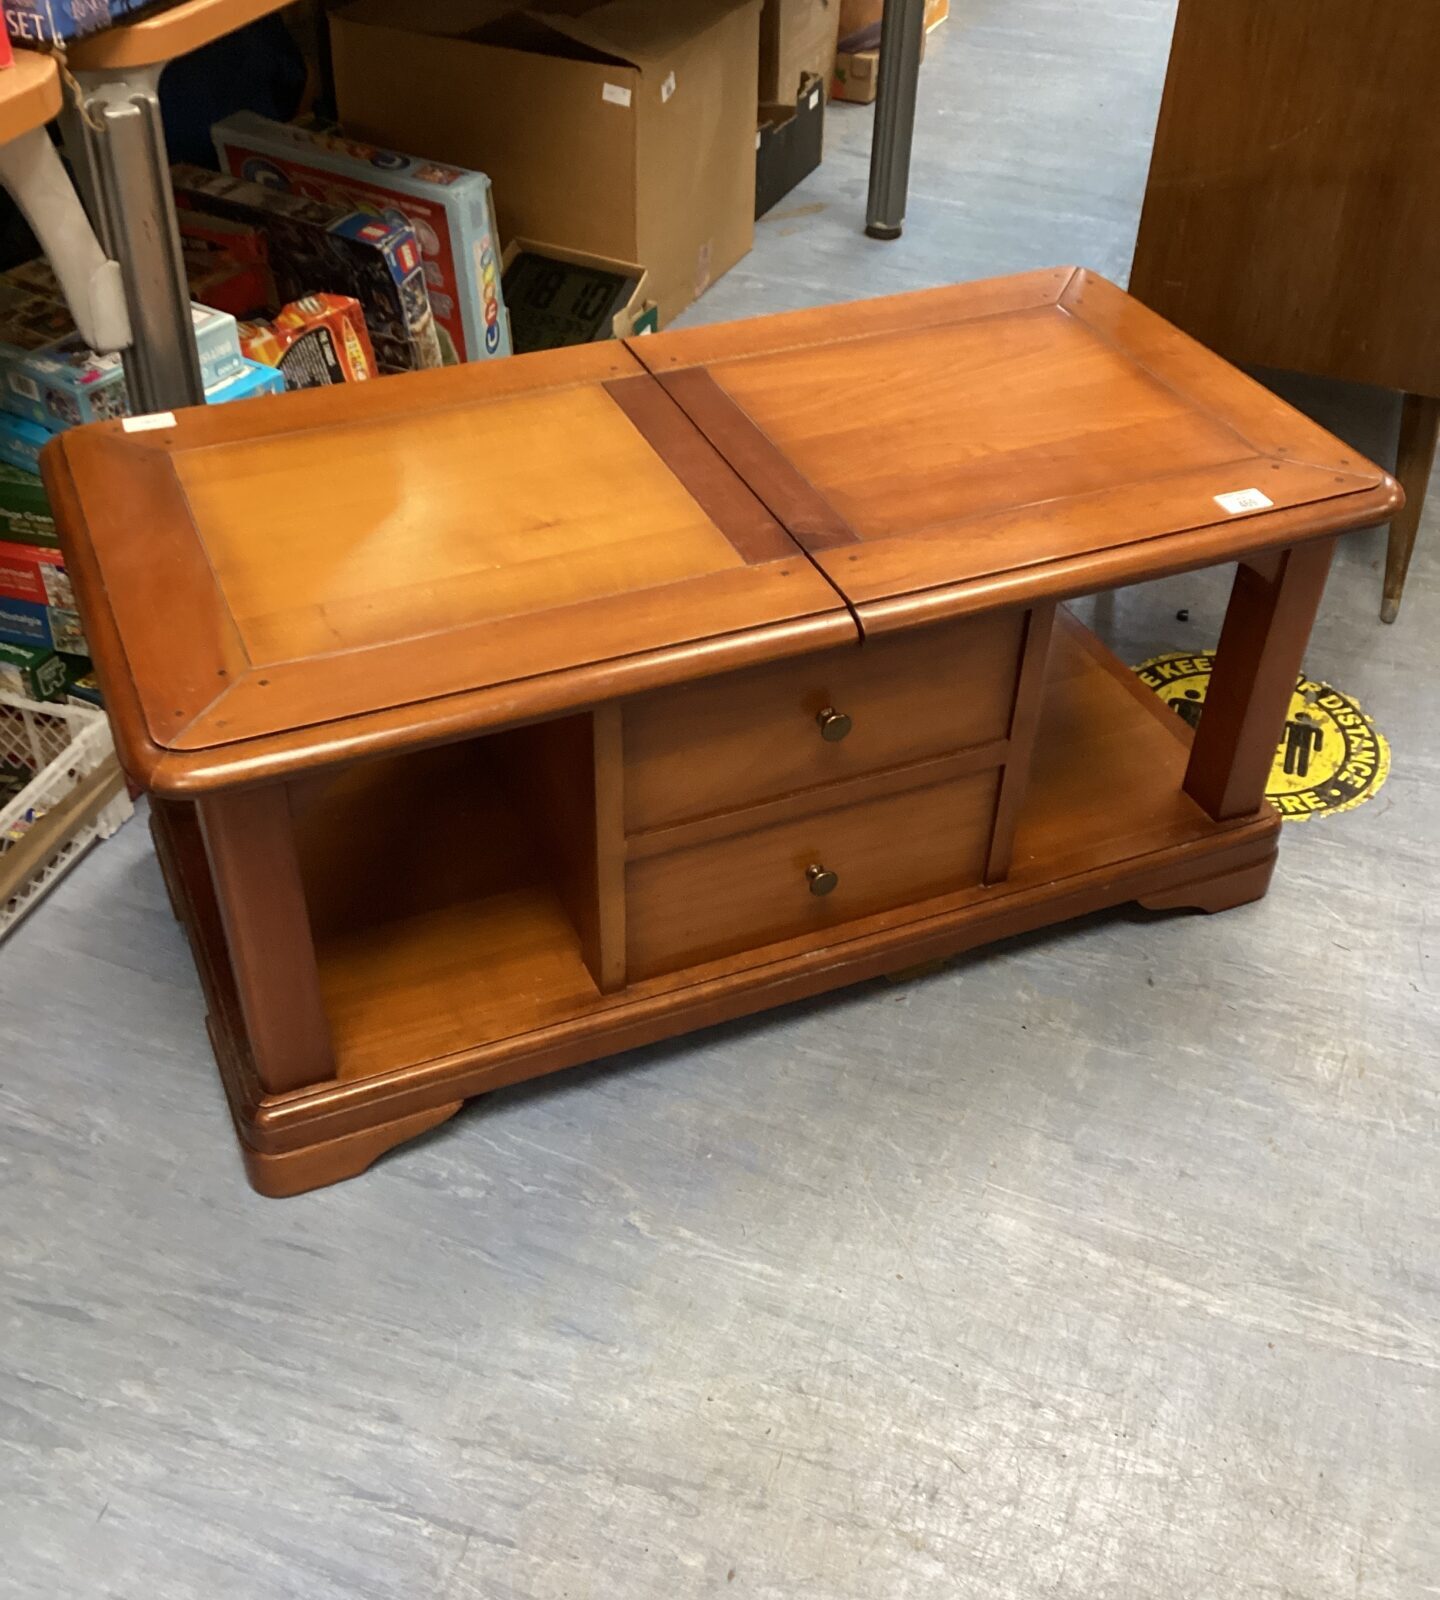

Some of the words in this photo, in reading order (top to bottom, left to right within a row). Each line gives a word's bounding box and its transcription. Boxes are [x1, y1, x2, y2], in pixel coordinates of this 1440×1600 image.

[6, 10, 44, 42] SET
[1155, 658, 1216, 679] KEE
[1318, 694, 1376, 789] DISTANCE
